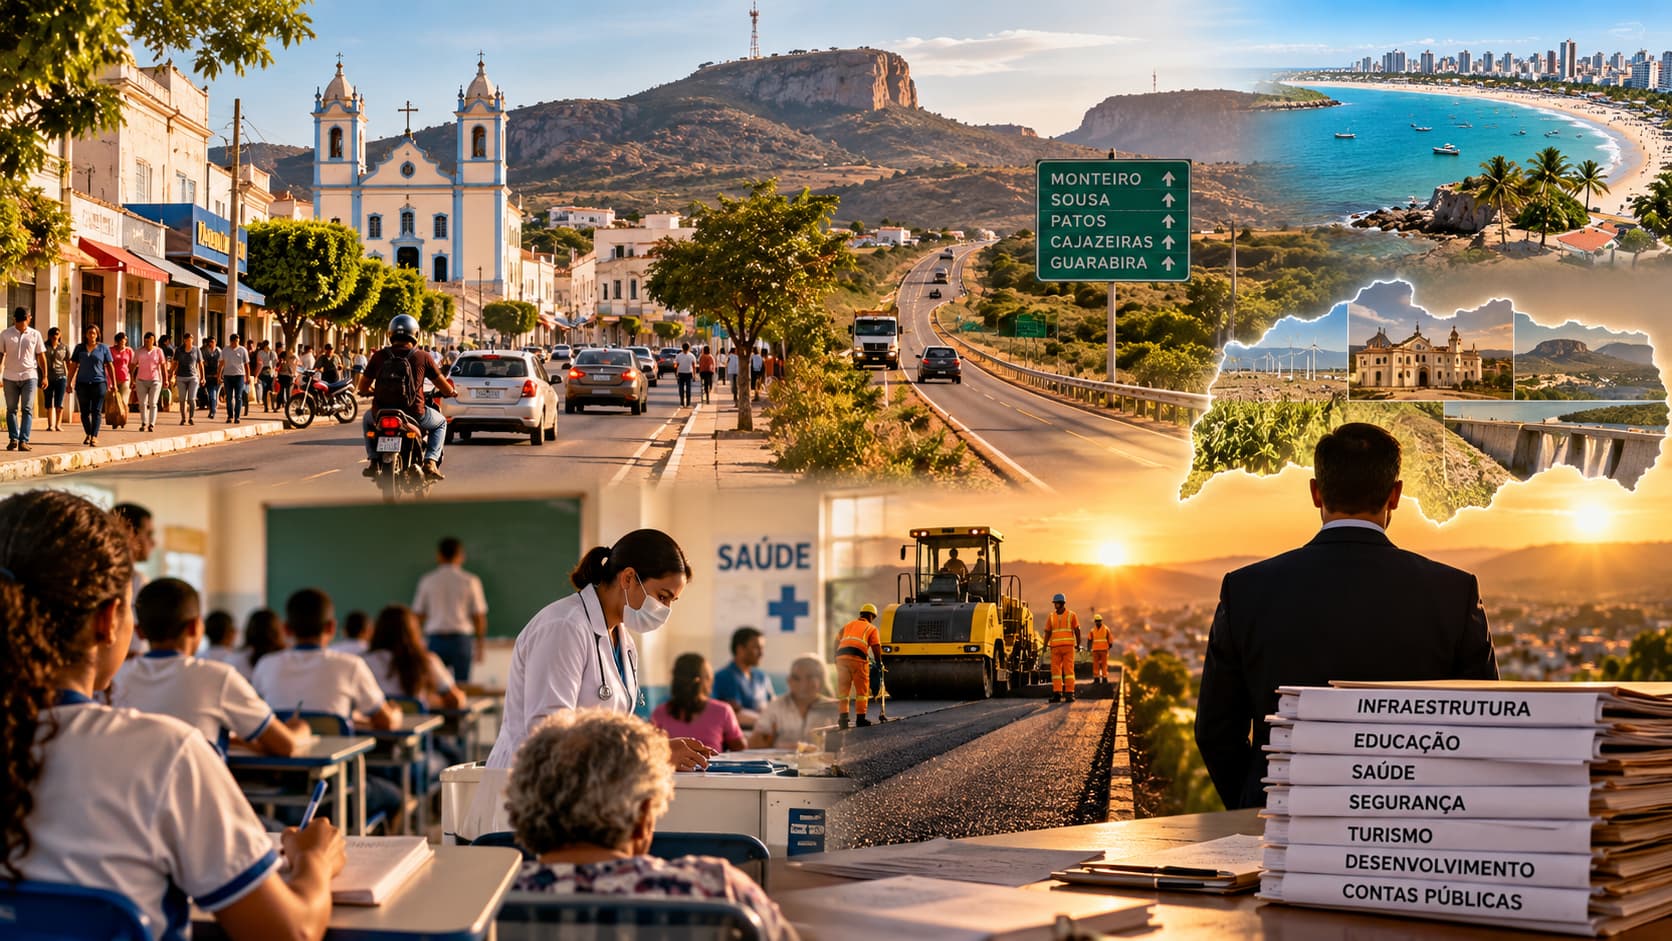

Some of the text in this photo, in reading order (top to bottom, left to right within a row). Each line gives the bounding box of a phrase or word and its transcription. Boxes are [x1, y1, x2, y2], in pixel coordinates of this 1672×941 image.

[1051, 172, 1142, 185] MONTEIRO
[1051, 193, 1110, 206] SOUSA
[1051, 214, 1107, 227] PATOS
[1050, 235, 1153, 248] CAJAZEIRAS
[1050, 256, 1148, 269] GUARABIRA
[717, 536, 812, 571] SAÚDE
[1357, 699, 1531, 716] INFRAESTRUTURA
[1354, 731, 1460, 753] EDUCAÇÃO
[1351, 761, 1416, 780] SAÚDE
[1349, 795, 1466, 814] SEGURANÇA
[1347, 827, 1433, 843] TURISMO
[1345, 854, 1535, 878] DESENVOLVIMENTO
[1342, 884, 1522, 910] CONTAS PÚBLICAS
